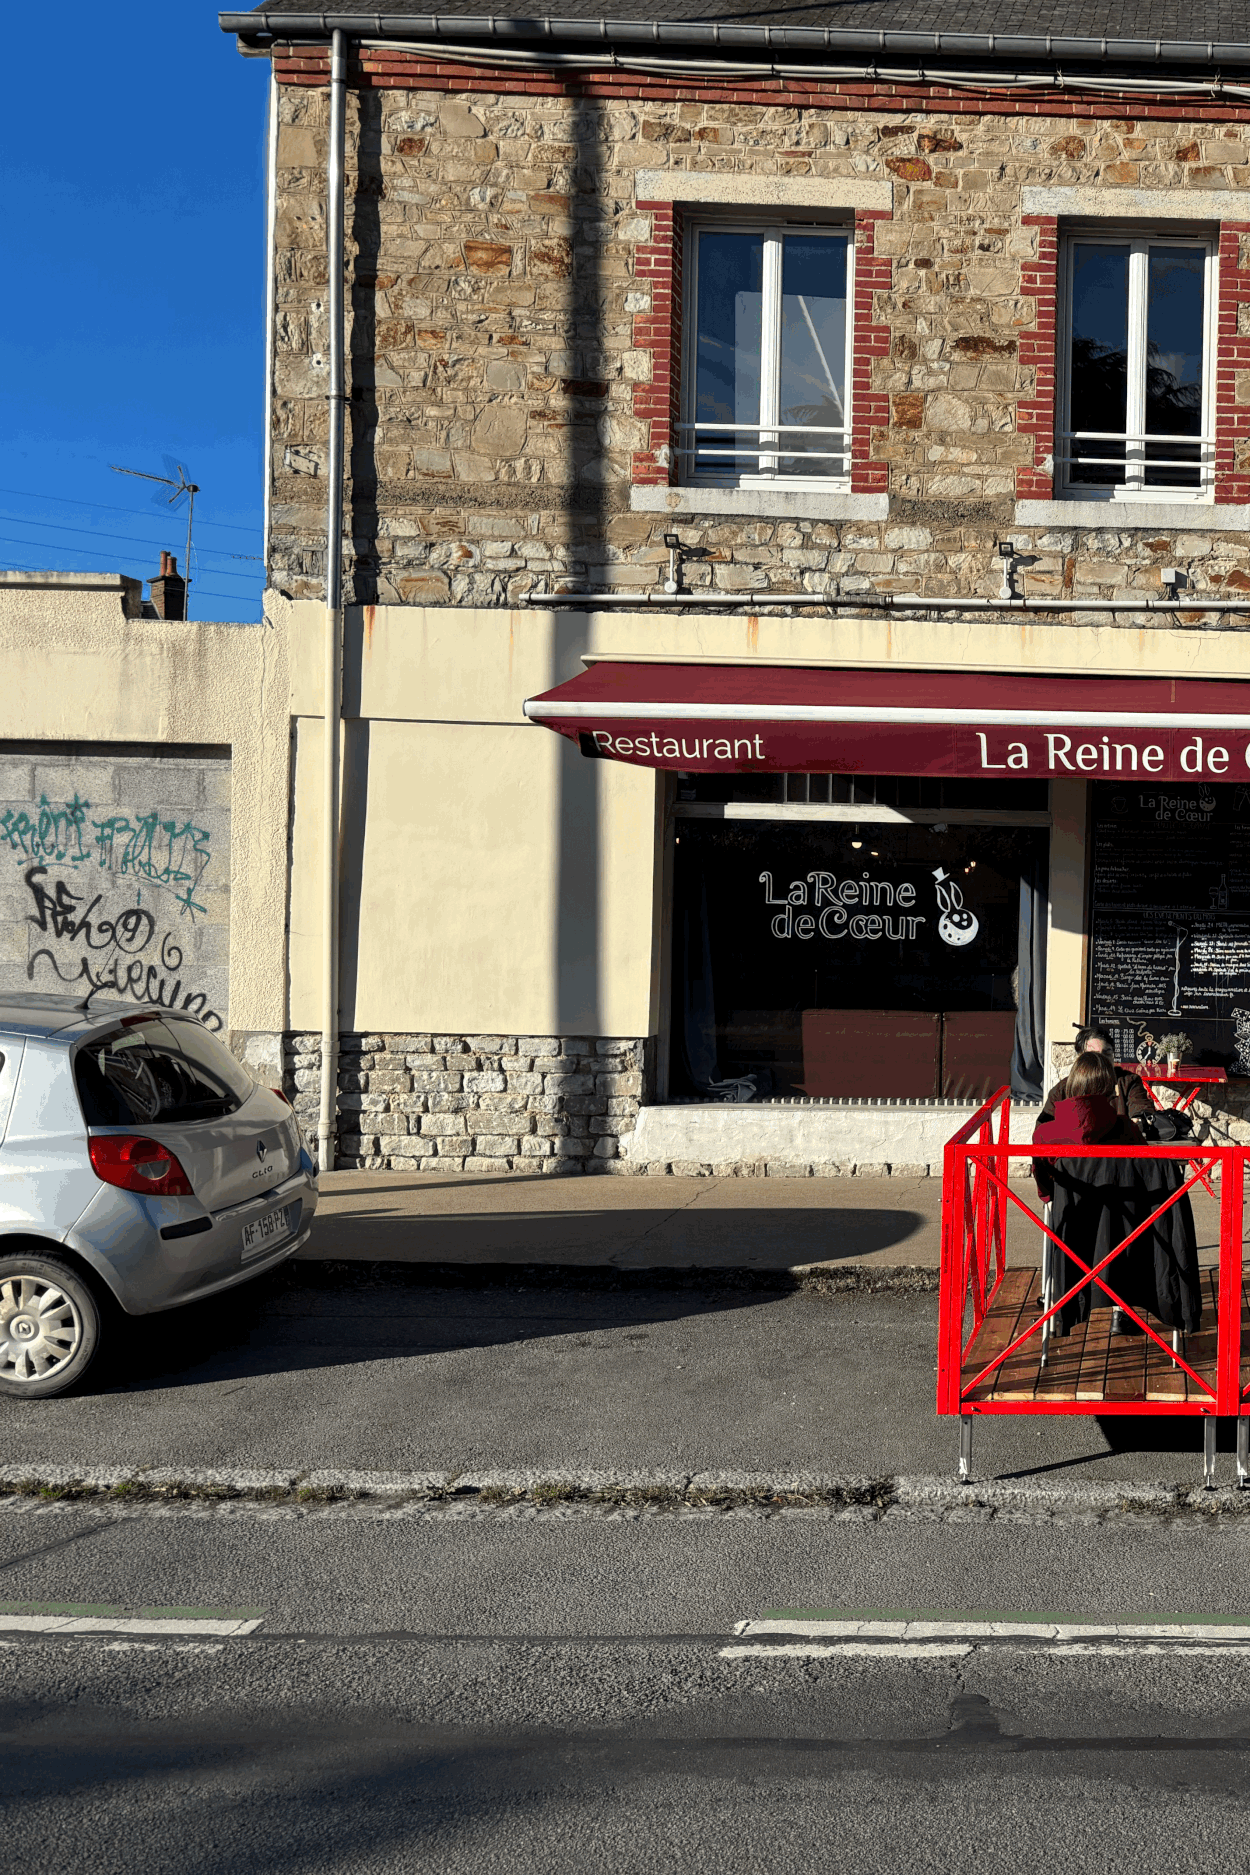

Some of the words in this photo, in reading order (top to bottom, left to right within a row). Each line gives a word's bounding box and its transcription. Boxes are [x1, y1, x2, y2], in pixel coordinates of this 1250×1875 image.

[592, 731, 766, 759] Restaurant
[975, 732, 1029, 769] La
[1043, 733, 1165, 773] Reine
[1179, 737, 1229, 774] de
[1137, 794, 1156, 808] La
[1157, 796, 1198, 810] Reine
[1155, 809, 1172, 821] de
[1175, 808, 1213, 822] Cœur
[758, 871, 808, 906] La
[807, 871, 916, 908] Reine
[770, 905, 816, 939] de
[818, 906, 926, 940] Cœur
[252, 1165, 273, 1179] CLIO
